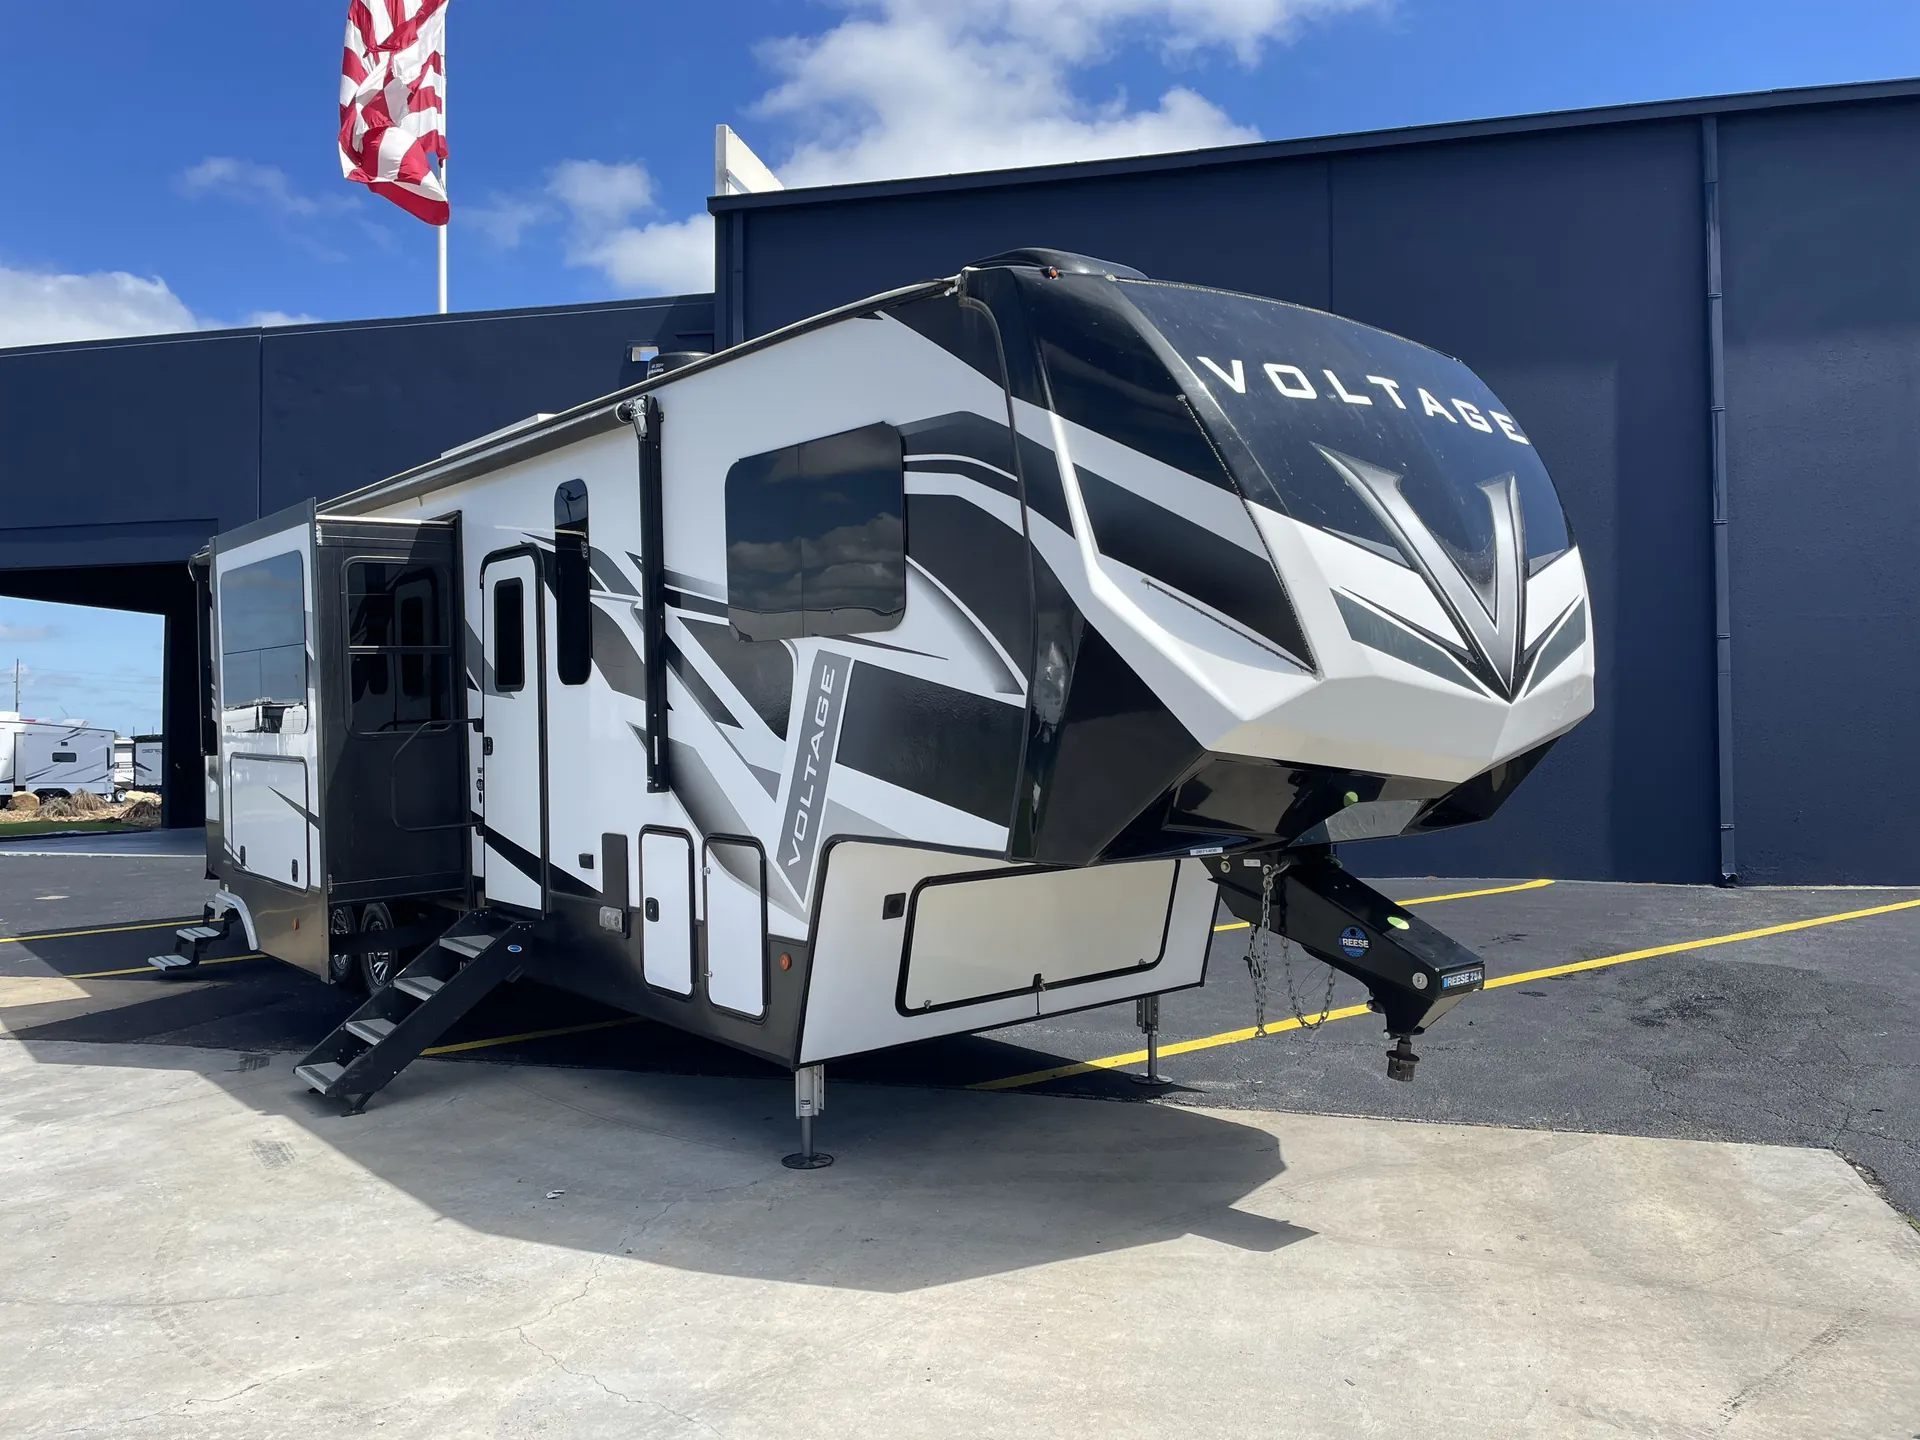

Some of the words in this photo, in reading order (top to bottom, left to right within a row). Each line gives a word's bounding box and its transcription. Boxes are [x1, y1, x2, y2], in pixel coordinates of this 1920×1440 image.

[1197, 355, 1530, 446] VOLTAGE
[788, 664, 836, 867] VOLTAGE
[1342, 937, 1370, 949] REESE
[1447, 973, 1470, 987] REESE
